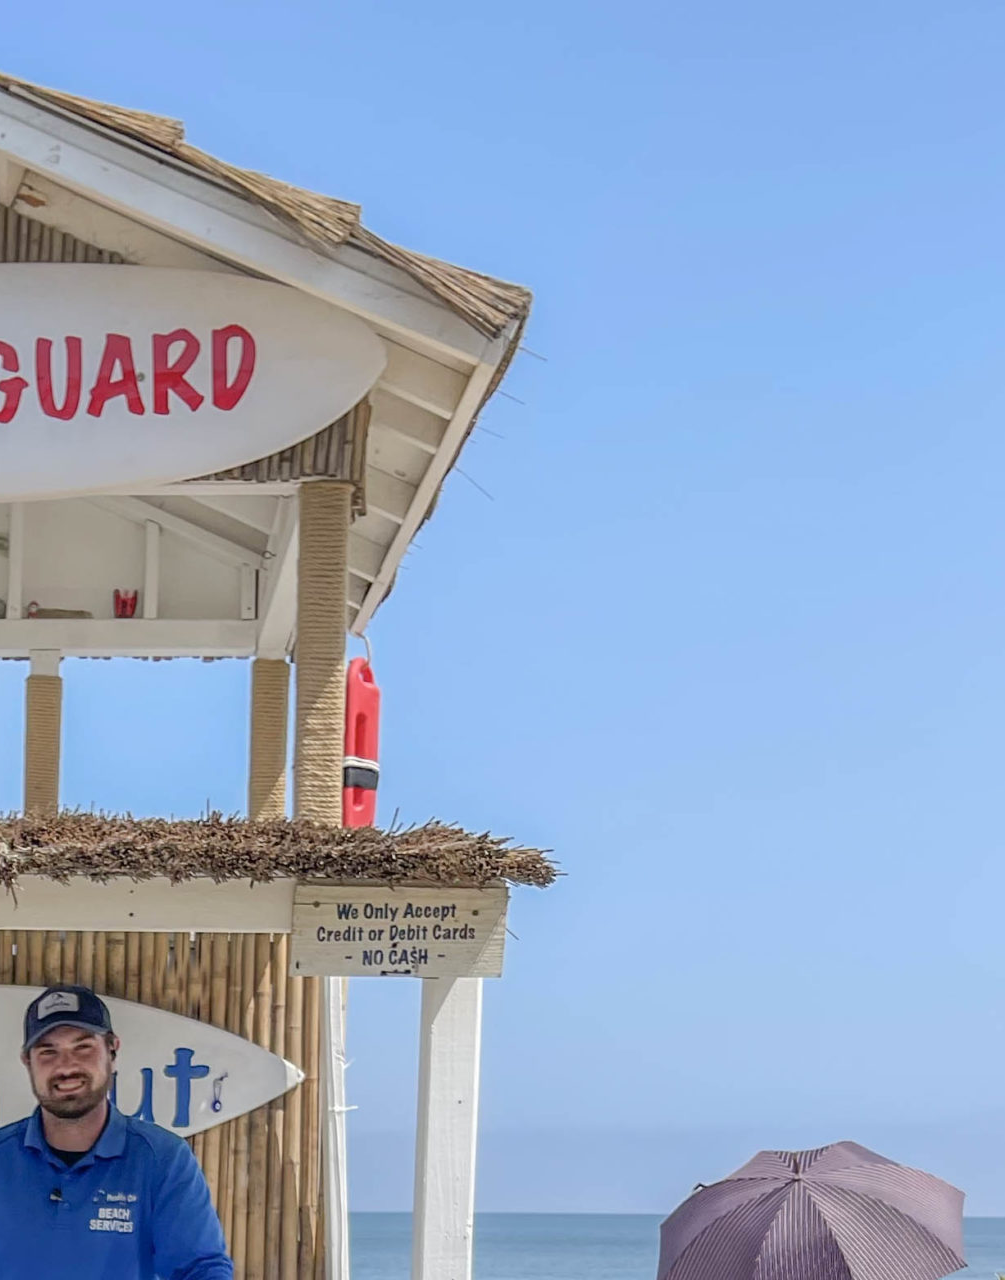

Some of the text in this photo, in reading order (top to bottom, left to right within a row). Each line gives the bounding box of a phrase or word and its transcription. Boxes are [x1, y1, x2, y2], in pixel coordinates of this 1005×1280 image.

[337, 903, 457, 922] We Only Accept
[317, 923, 476, 942] Credit or Debit Cards
[362, 950, 384, 966] NO
[99, 1208, 130, 1219] BEACH
[90, 1219, 134, 1232] SERVICES
